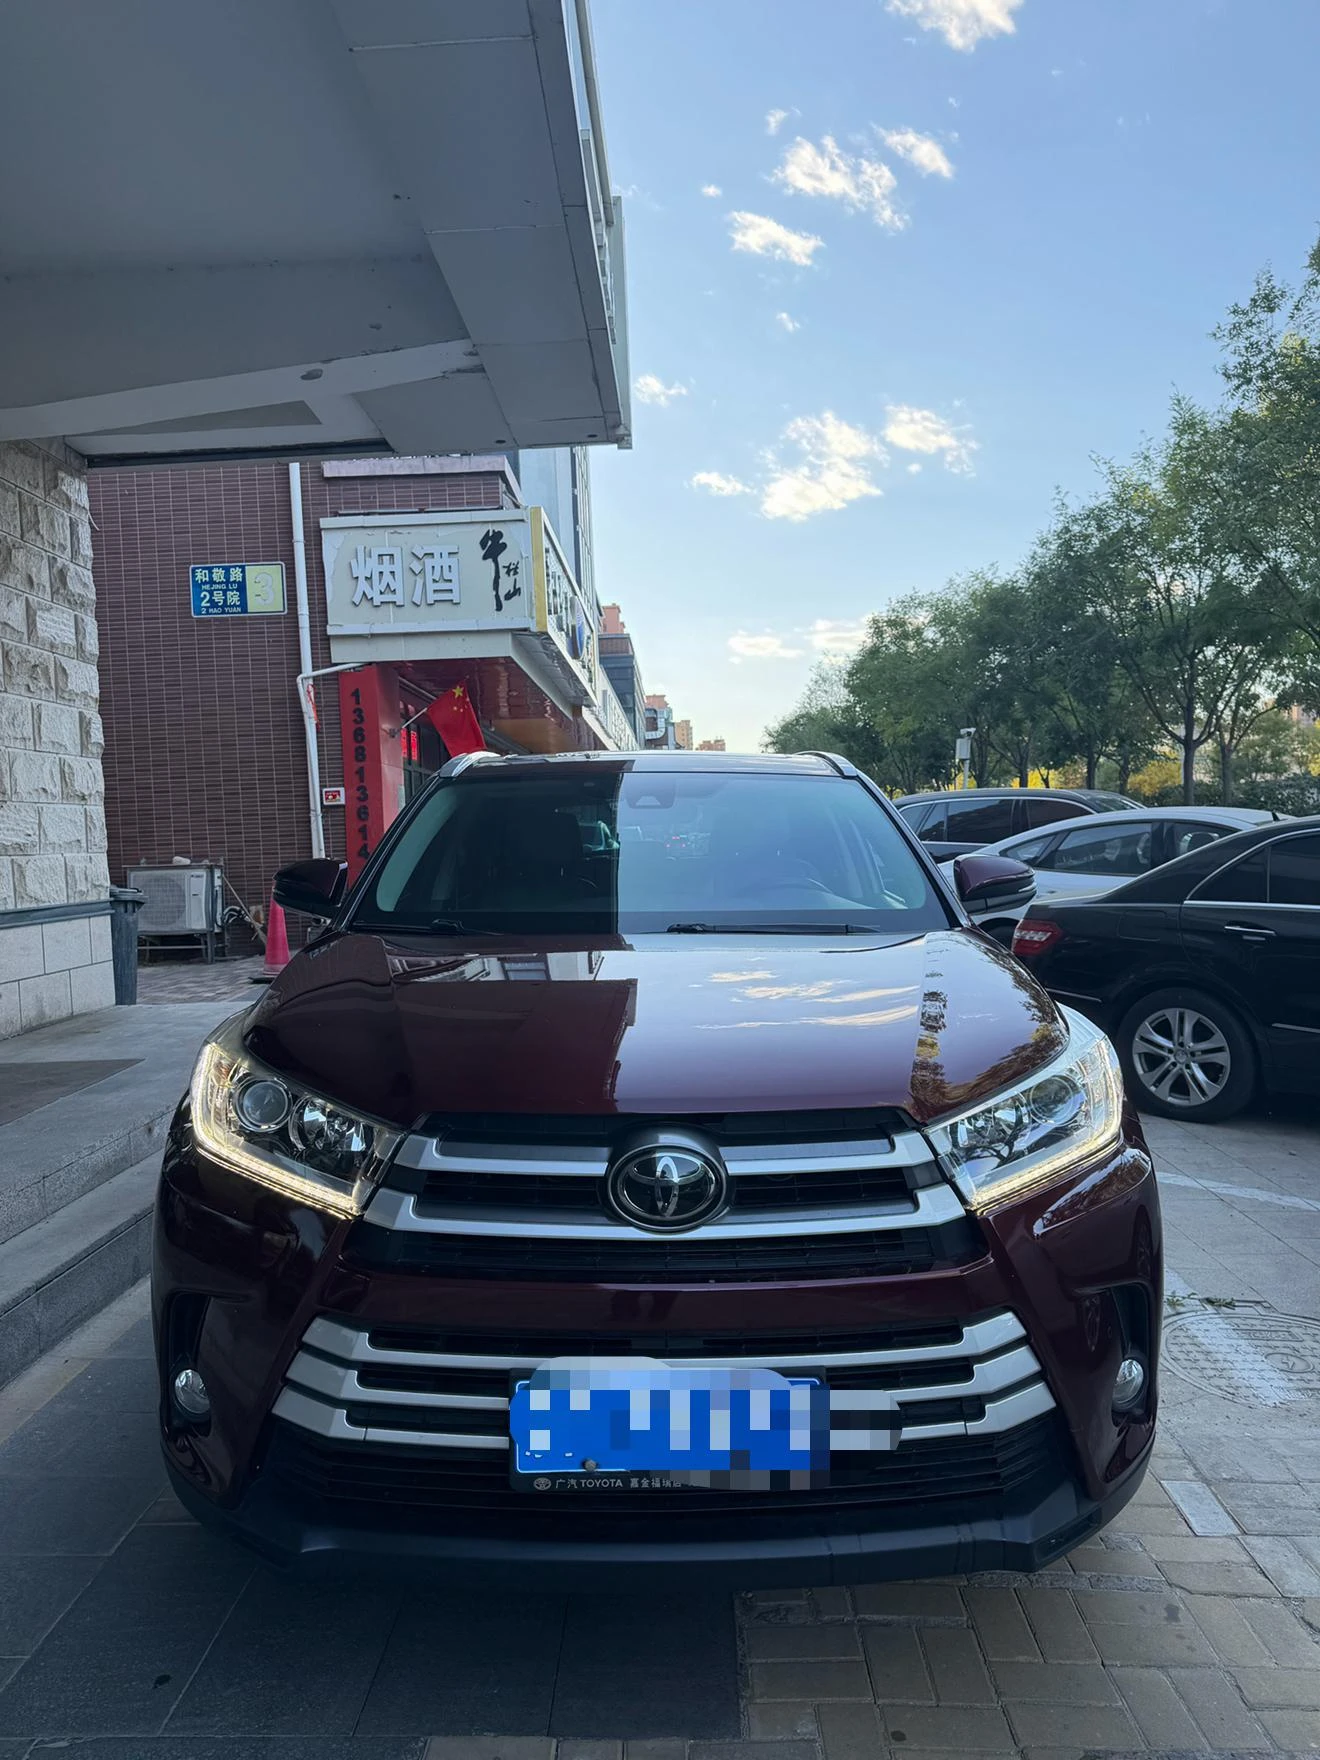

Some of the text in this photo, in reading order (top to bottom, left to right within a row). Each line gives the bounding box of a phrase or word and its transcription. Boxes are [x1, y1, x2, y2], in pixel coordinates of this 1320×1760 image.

[195, 566, 243, 583] 和敬路
[350, 544, 460, 608] 烟酒
[200, 590, 241, 607] 2号院
[579, 1478, 624, 1488] TOYOTA
